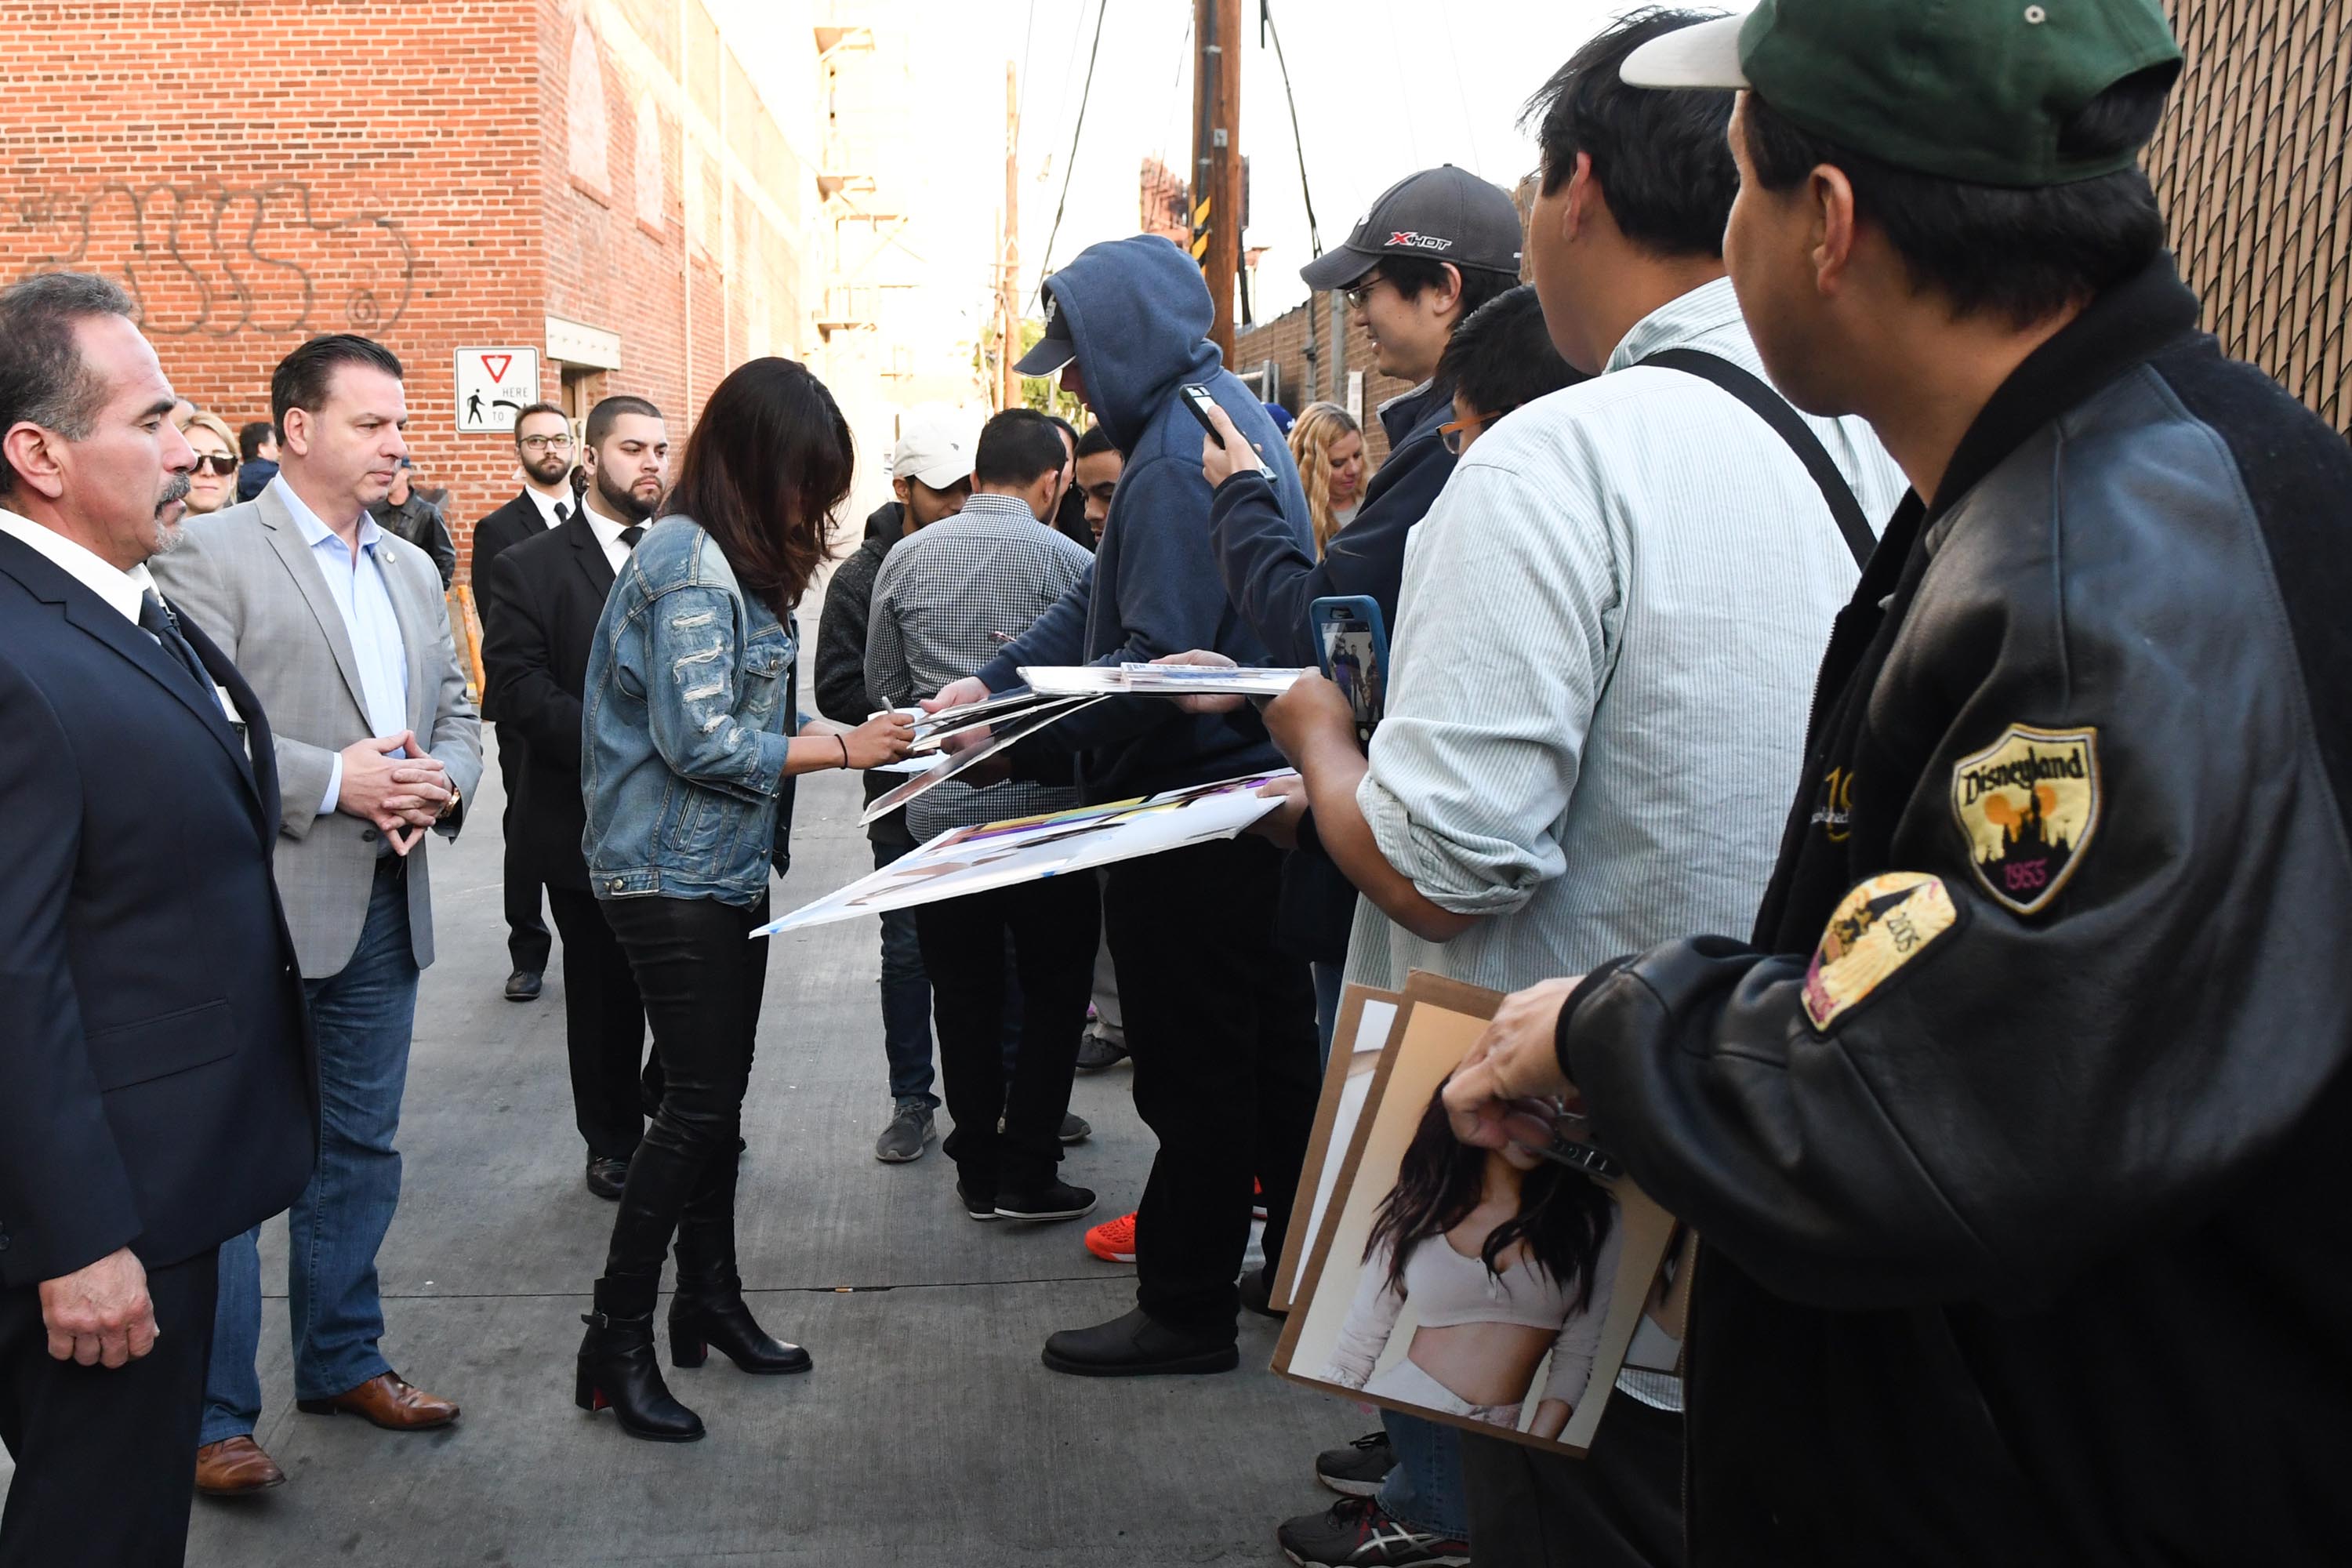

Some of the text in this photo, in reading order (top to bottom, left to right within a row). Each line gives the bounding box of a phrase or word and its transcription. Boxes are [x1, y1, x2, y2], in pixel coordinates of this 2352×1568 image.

[503, 387, 528, 397] HERE
[492, 411, 504, 421] TO
[1963, 746, 2085, 806] Disneyland
[2003, 856, 2049, 891] 1955
[1886, 911, 1921, 953] 2005
